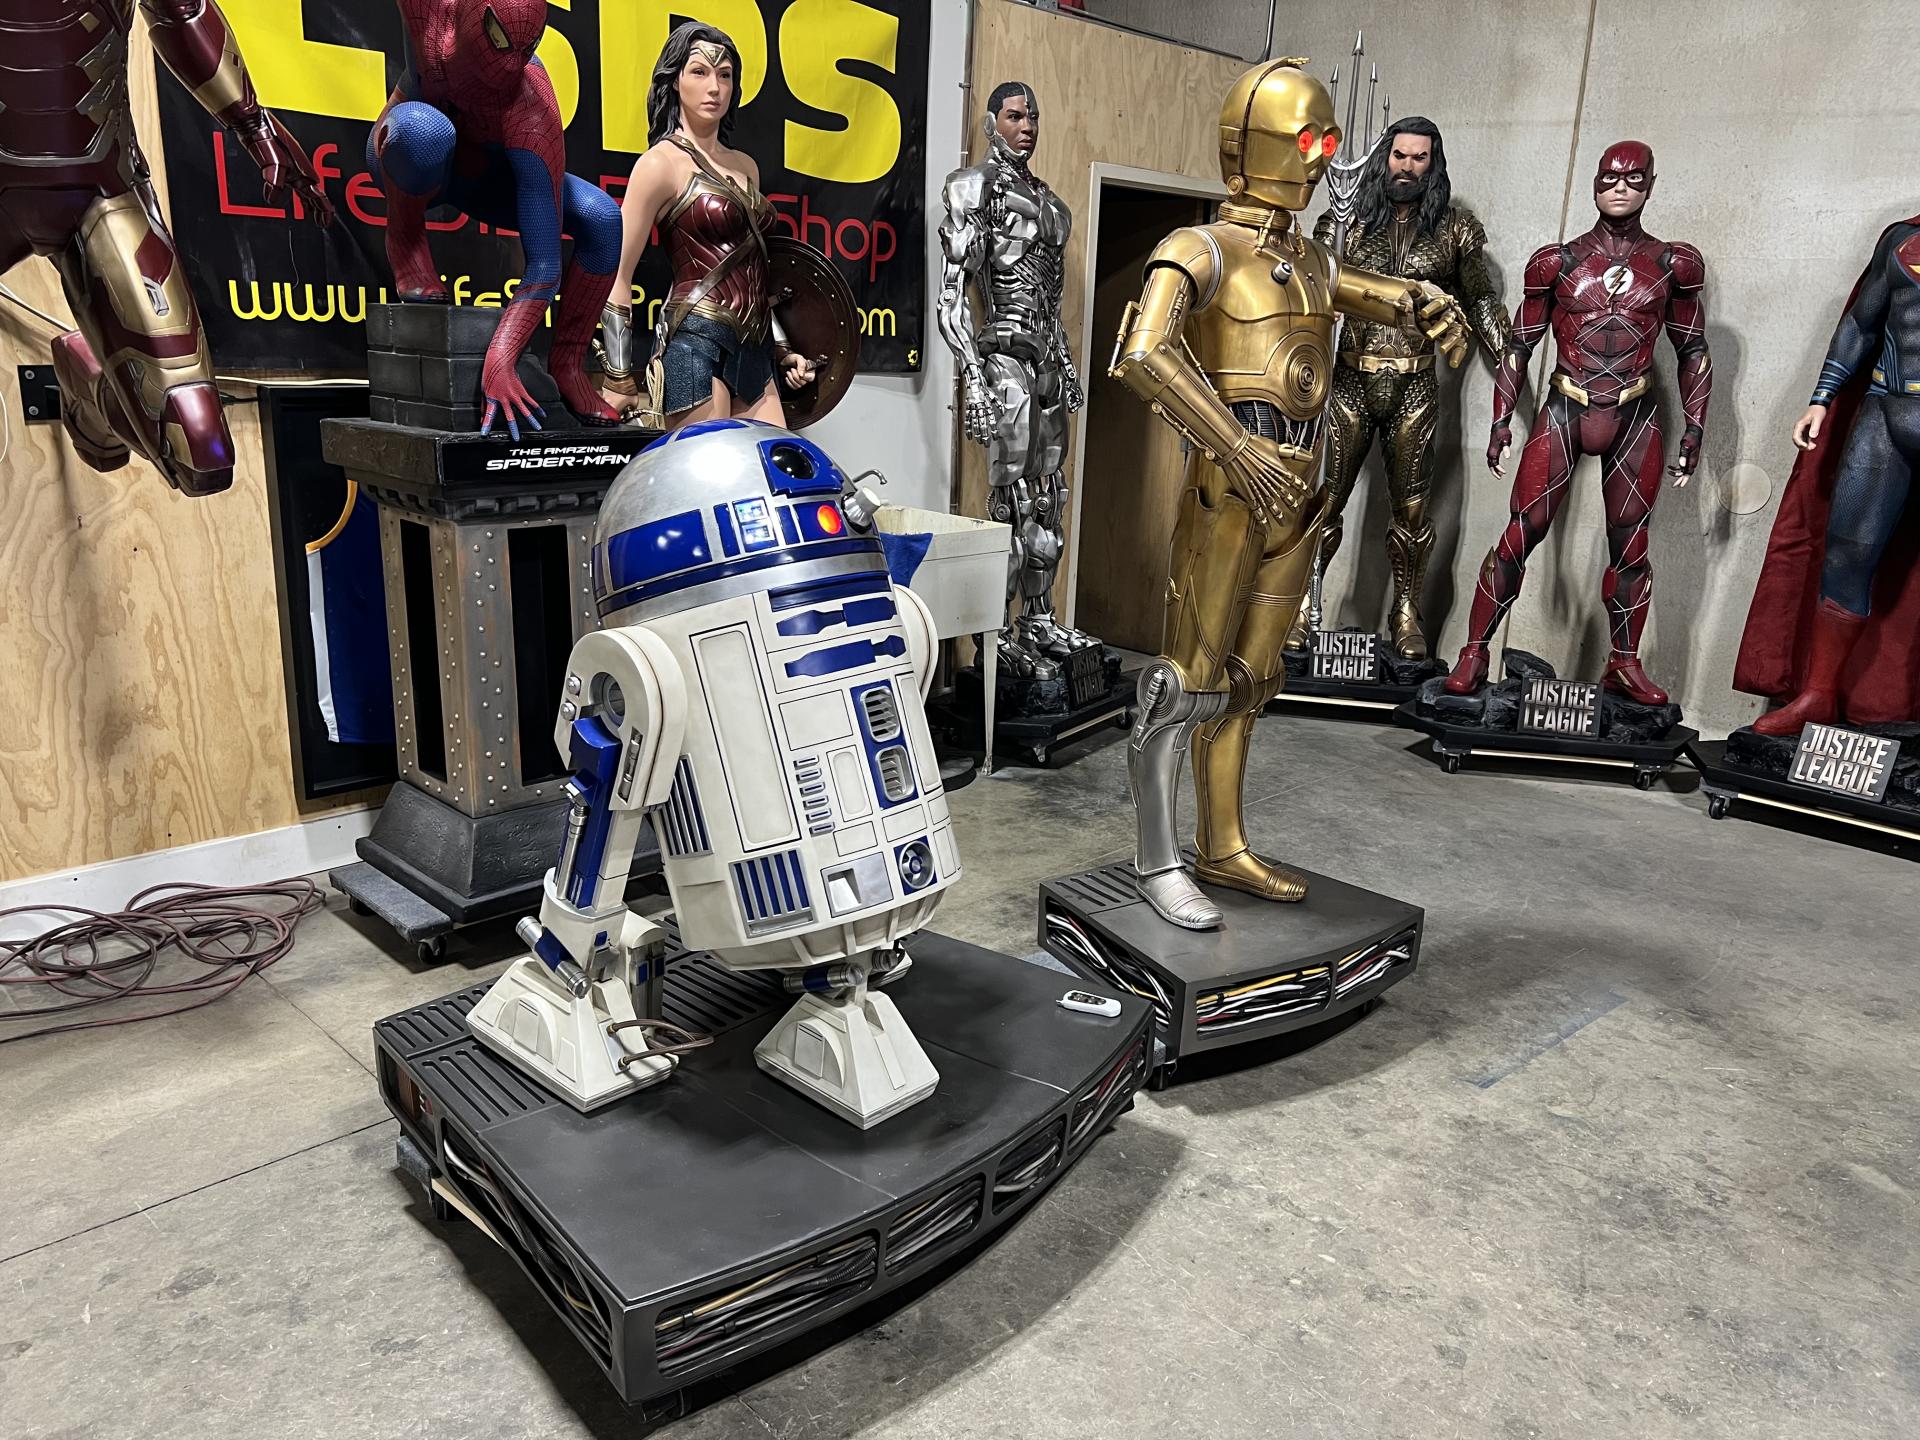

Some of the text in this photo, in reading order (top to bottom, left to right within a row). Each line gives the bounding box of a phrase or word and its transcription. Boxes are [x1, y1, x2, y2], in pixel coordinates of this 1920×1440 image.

[486, 454, 631, 471] SPIDER-MAN
[509, 445, 610, 457] THE AMAZING
[1313, 631, 1376, 658] JUSTICE
[1313, 655, 1376, 681] LEAGUE
[1524, 678, 1597, 710] JUSTICE
[1523, 703, 1595, 737] LEAGUE
[1801, 724, 1892, 769] JUSTICE
[1794, 752, 1883, 797] LEAGUE
